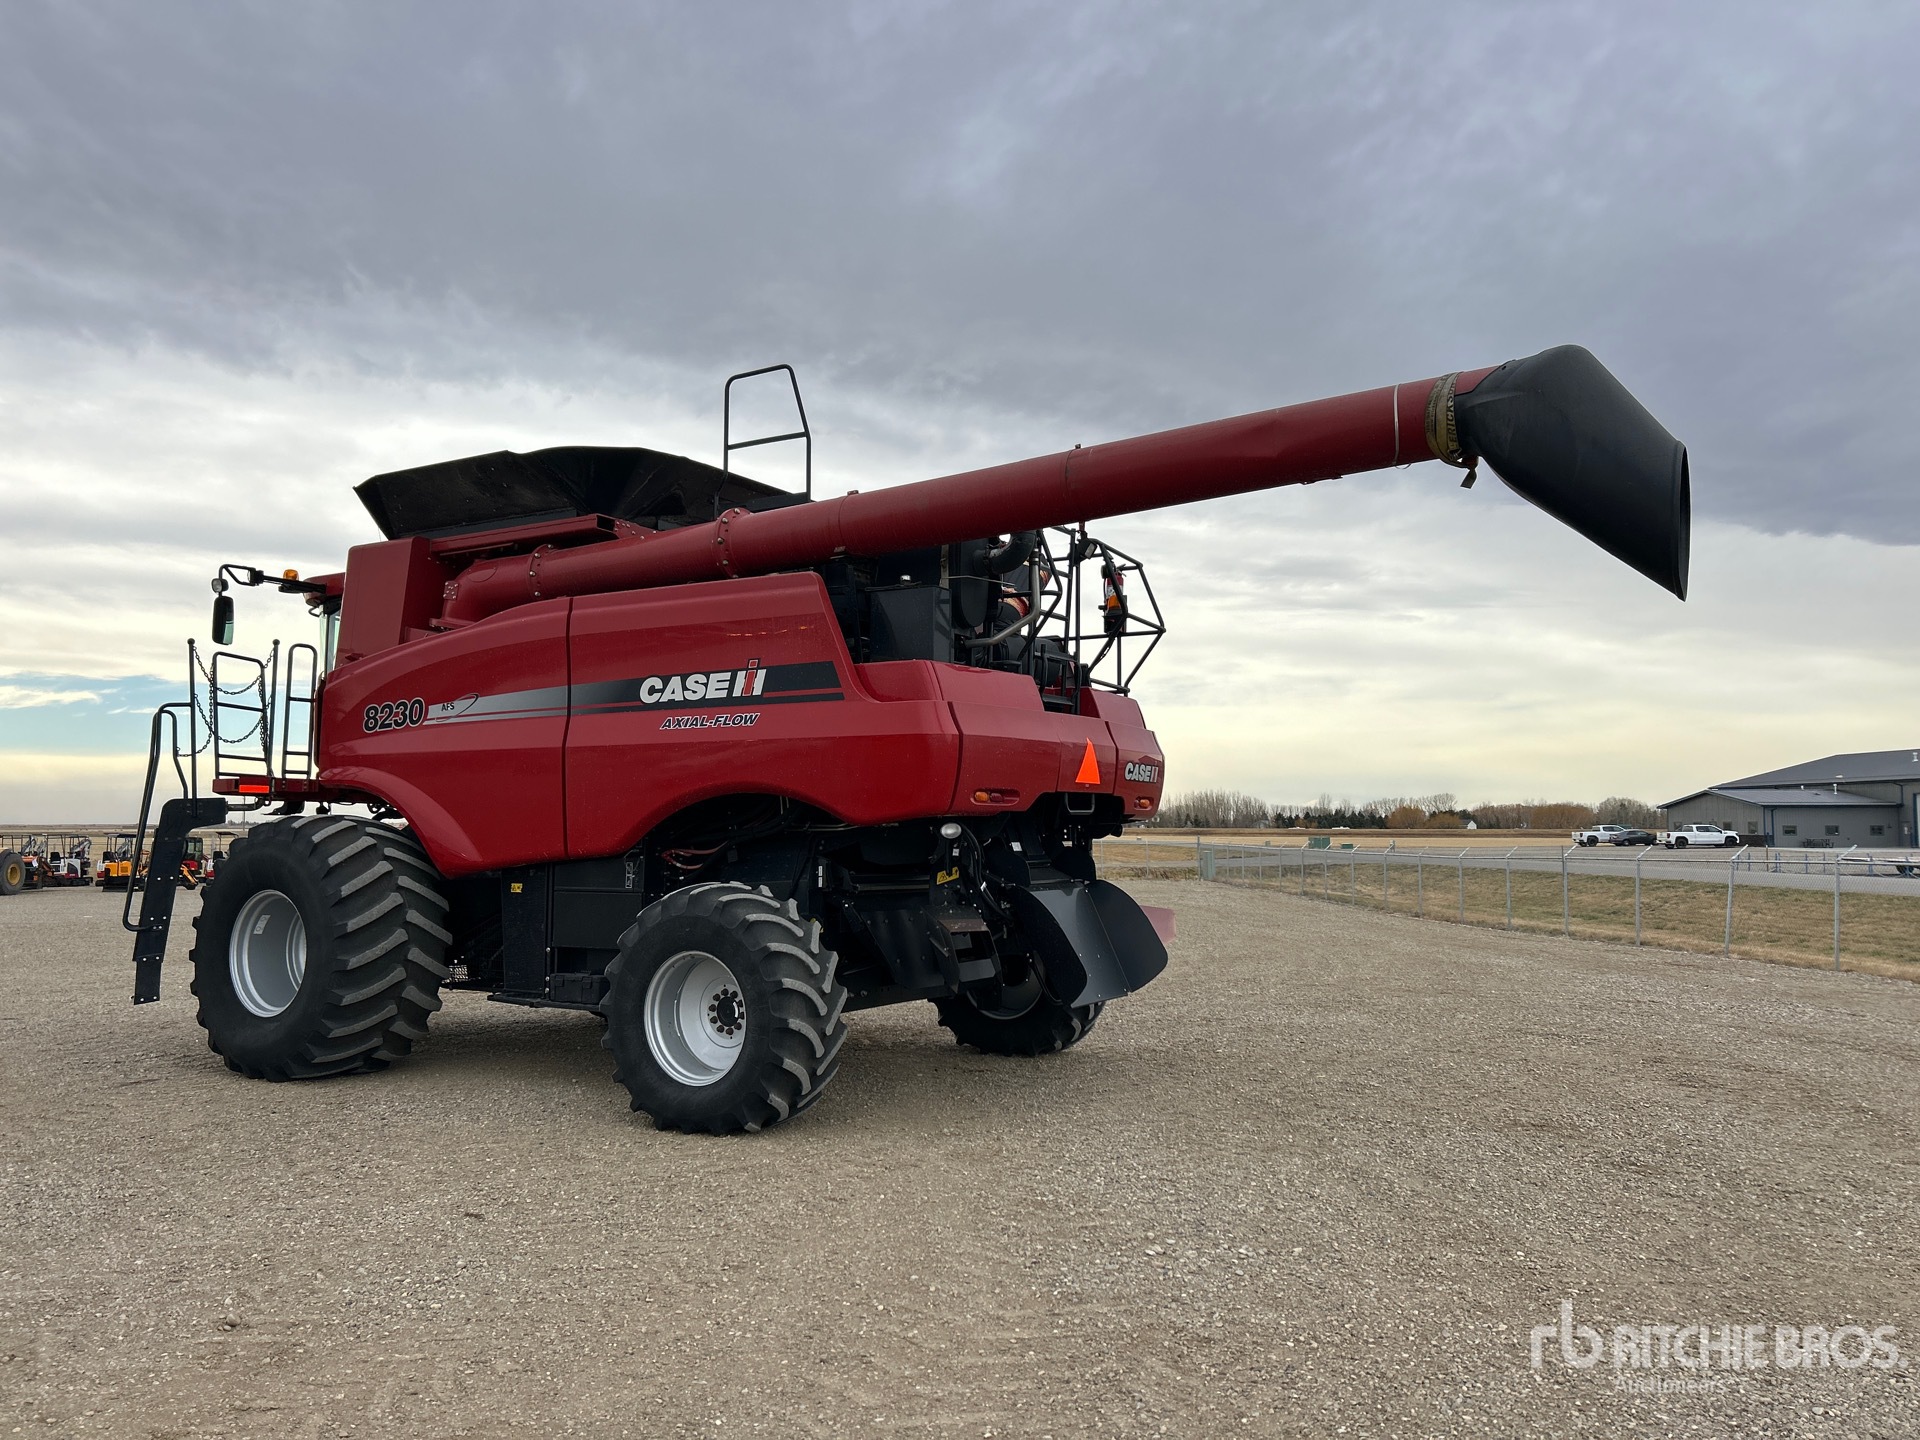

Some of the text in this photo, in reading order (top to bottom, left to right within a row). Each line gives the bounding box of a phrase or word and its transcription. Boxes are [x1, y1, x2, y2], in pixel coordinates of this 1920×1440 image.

[639, 671, 732, 704] CASE
[363, 698, 425, 734] 8230
[441, 702, 455, 712] AFS
[660, 713, 761, 730] AXIAL-FLOW
